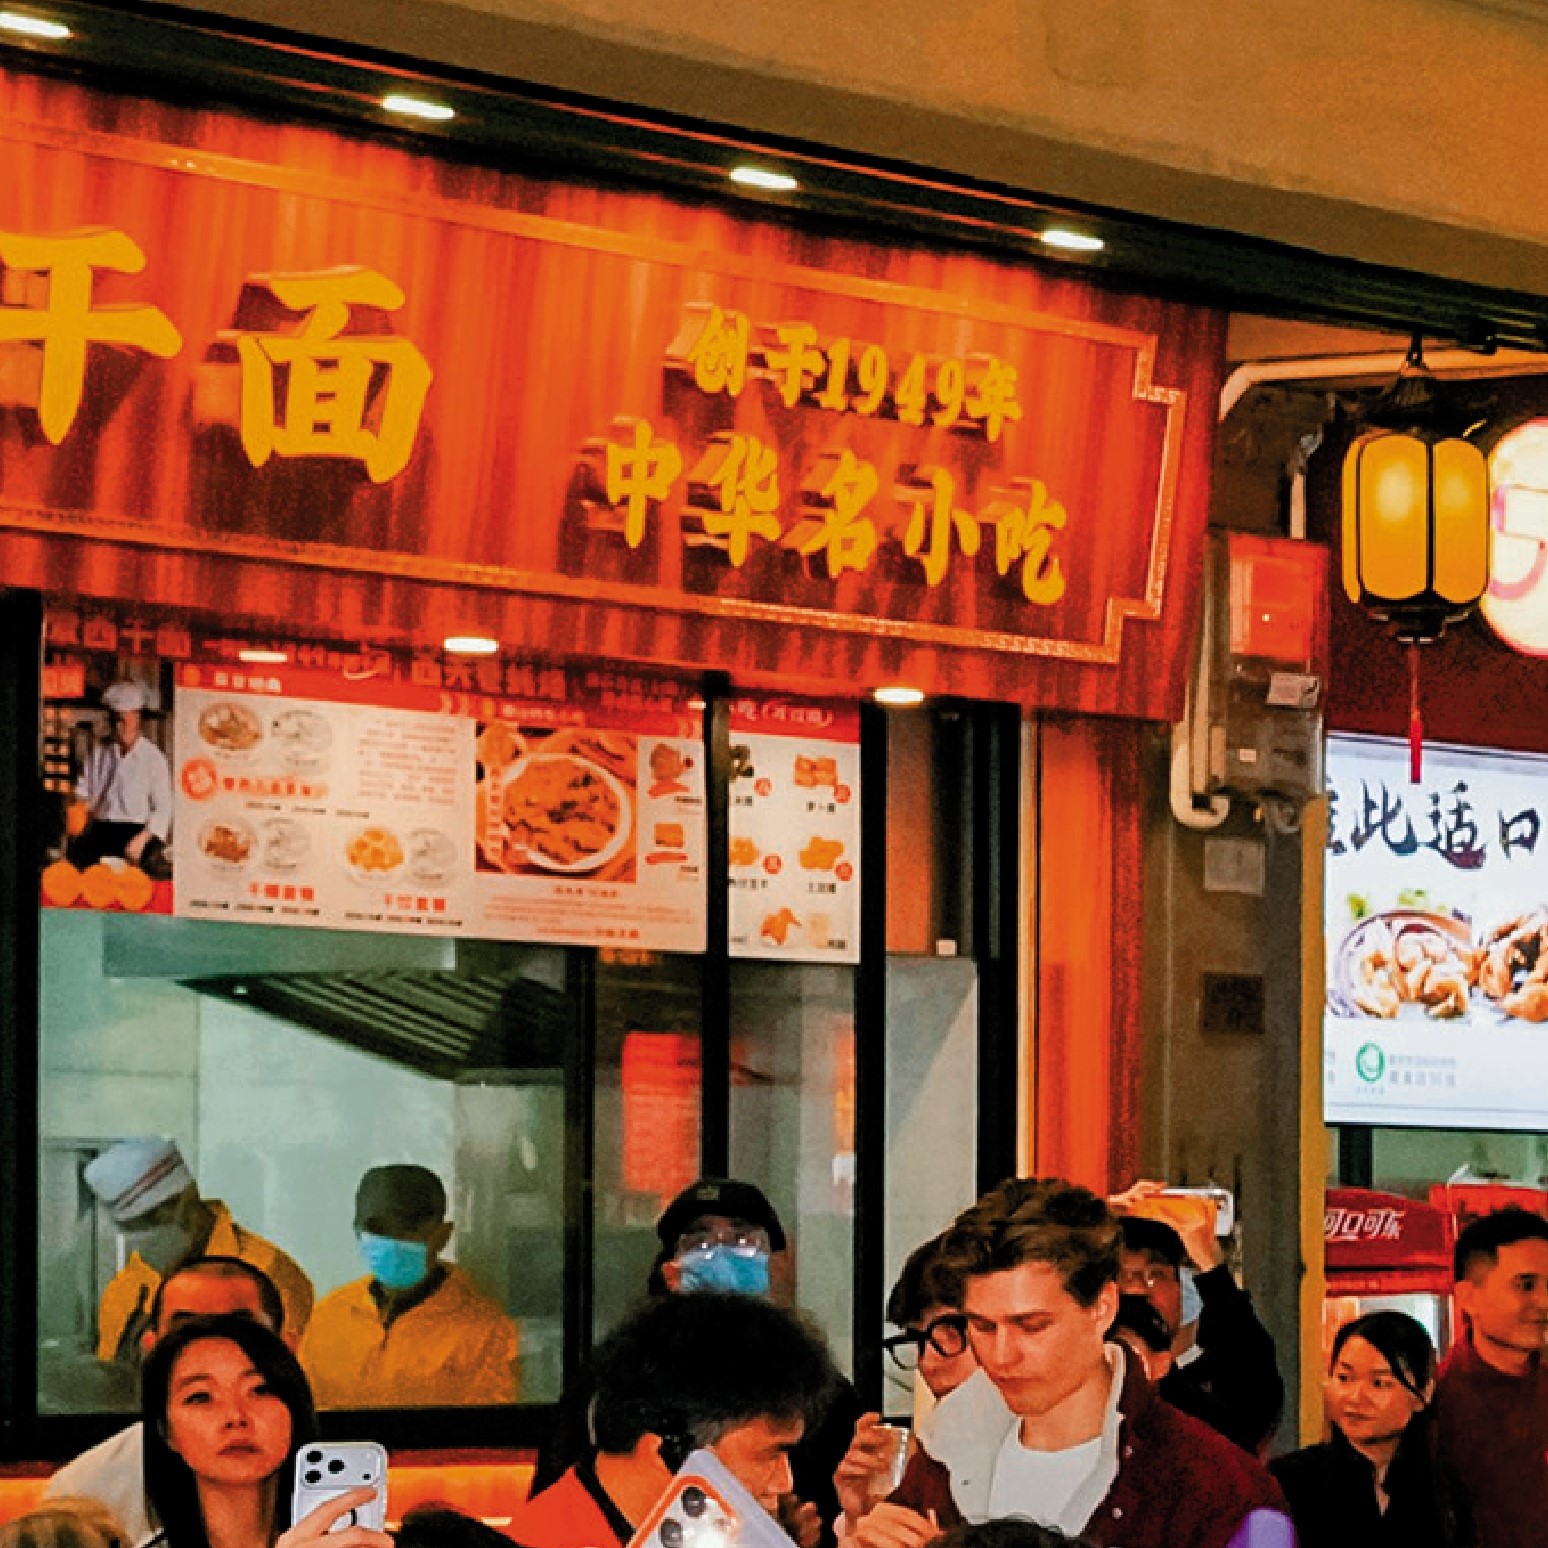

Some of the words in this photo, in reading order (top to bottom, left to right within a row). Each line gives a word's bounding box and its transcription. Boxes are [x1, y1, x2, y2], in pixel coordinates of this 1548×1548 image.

[0, 227, 433, 484] 干面
[688, 308, 1022, 441] 创于1949年
[602, 416, 1067, 606] 中华名小吃
